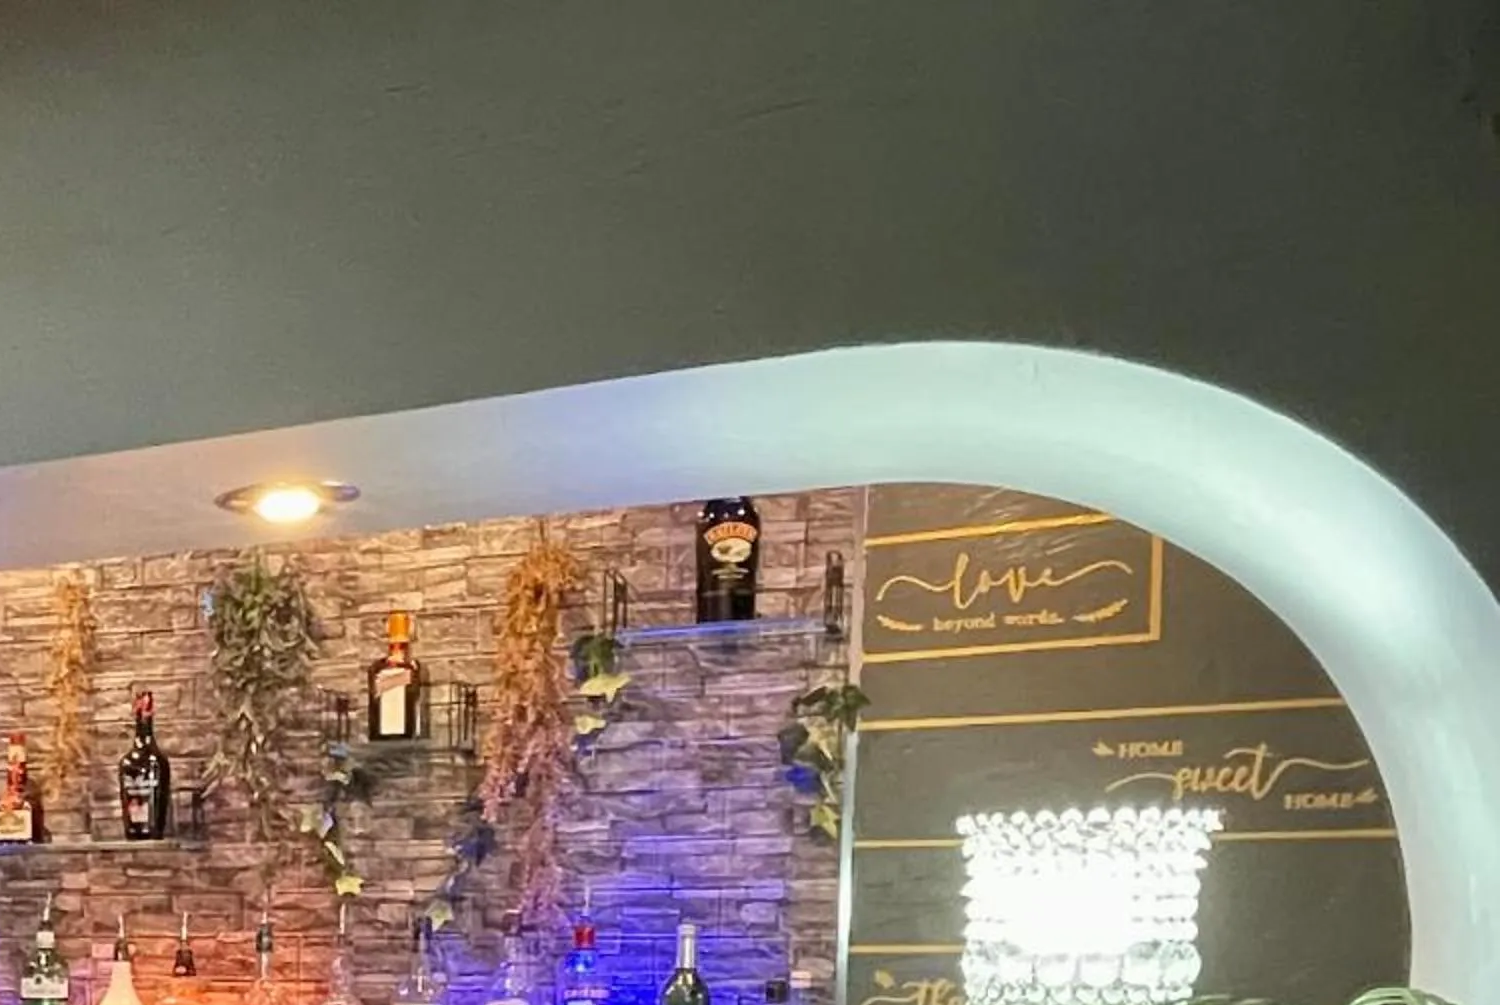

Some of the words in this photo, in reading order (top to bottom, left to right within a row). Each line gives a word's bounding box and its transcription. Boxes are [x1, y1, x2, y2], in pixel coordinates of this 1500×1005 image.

[940, 552, 1072, 610] love
[932, 611, 997, 634] beyond
[1118, 740, 1183, 759] HOME
[1160, 741, 1295, 801] sweet
[1284, 792, 1354, 810] HOME
